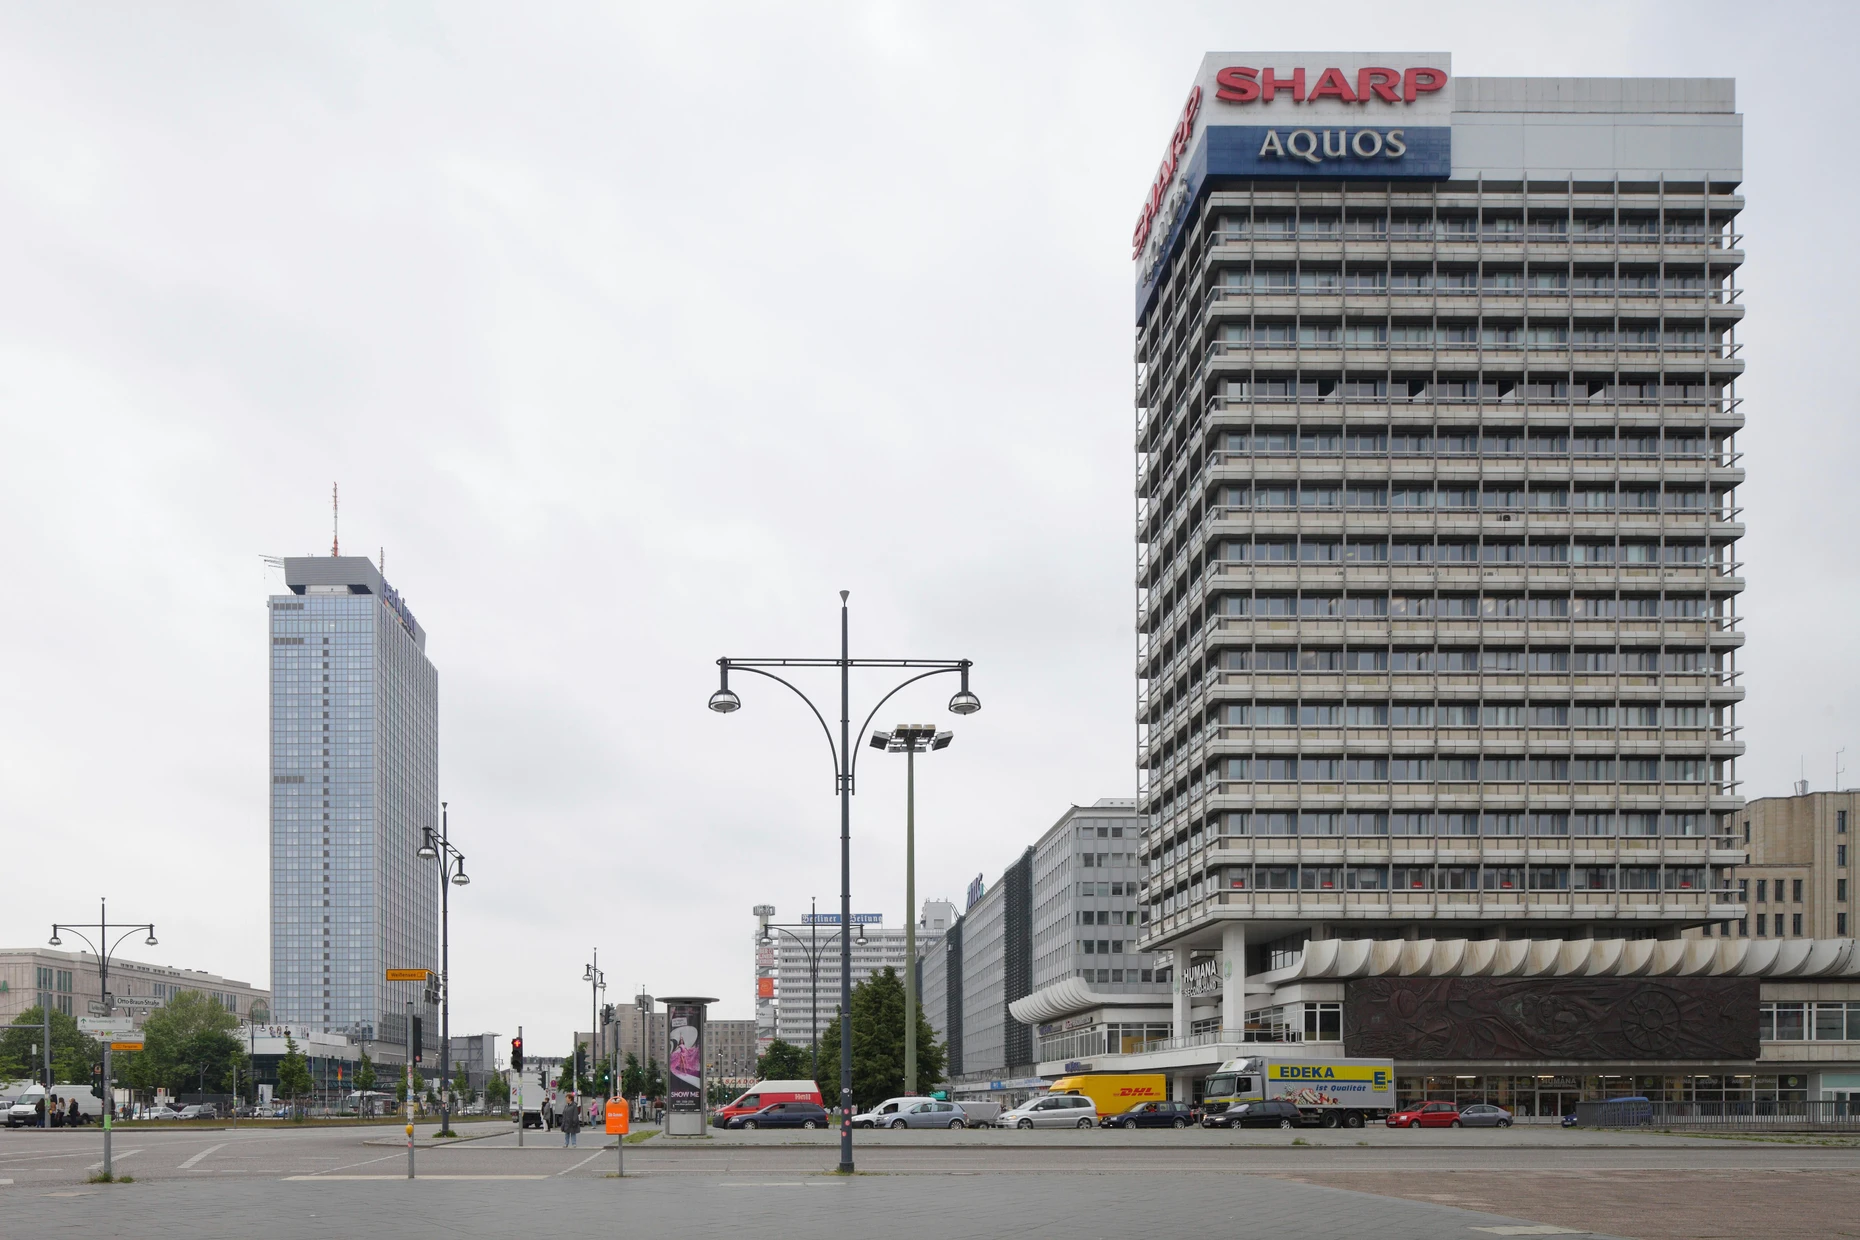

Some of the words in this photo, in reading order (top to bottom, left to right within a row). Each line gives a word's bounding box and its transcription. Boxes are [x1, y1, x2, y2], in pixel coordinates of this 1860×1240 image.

[1215, 66, 1448, 103] SHARP
[1258, 128, 1408, 165] AQUOS
[1132, 85, 1201, 261] SHARP
[801, 913, 837, 923] Berliner
[1183, 960, 1218, 984] HUMANA
[1280, 1066, 1335, 1079] EDEKA
[1120, 1087, 1154, 1097] DHL
[1315, 1084, 1328, 1092] ist
[1330, 1084, 1367, 1092] Qualität
